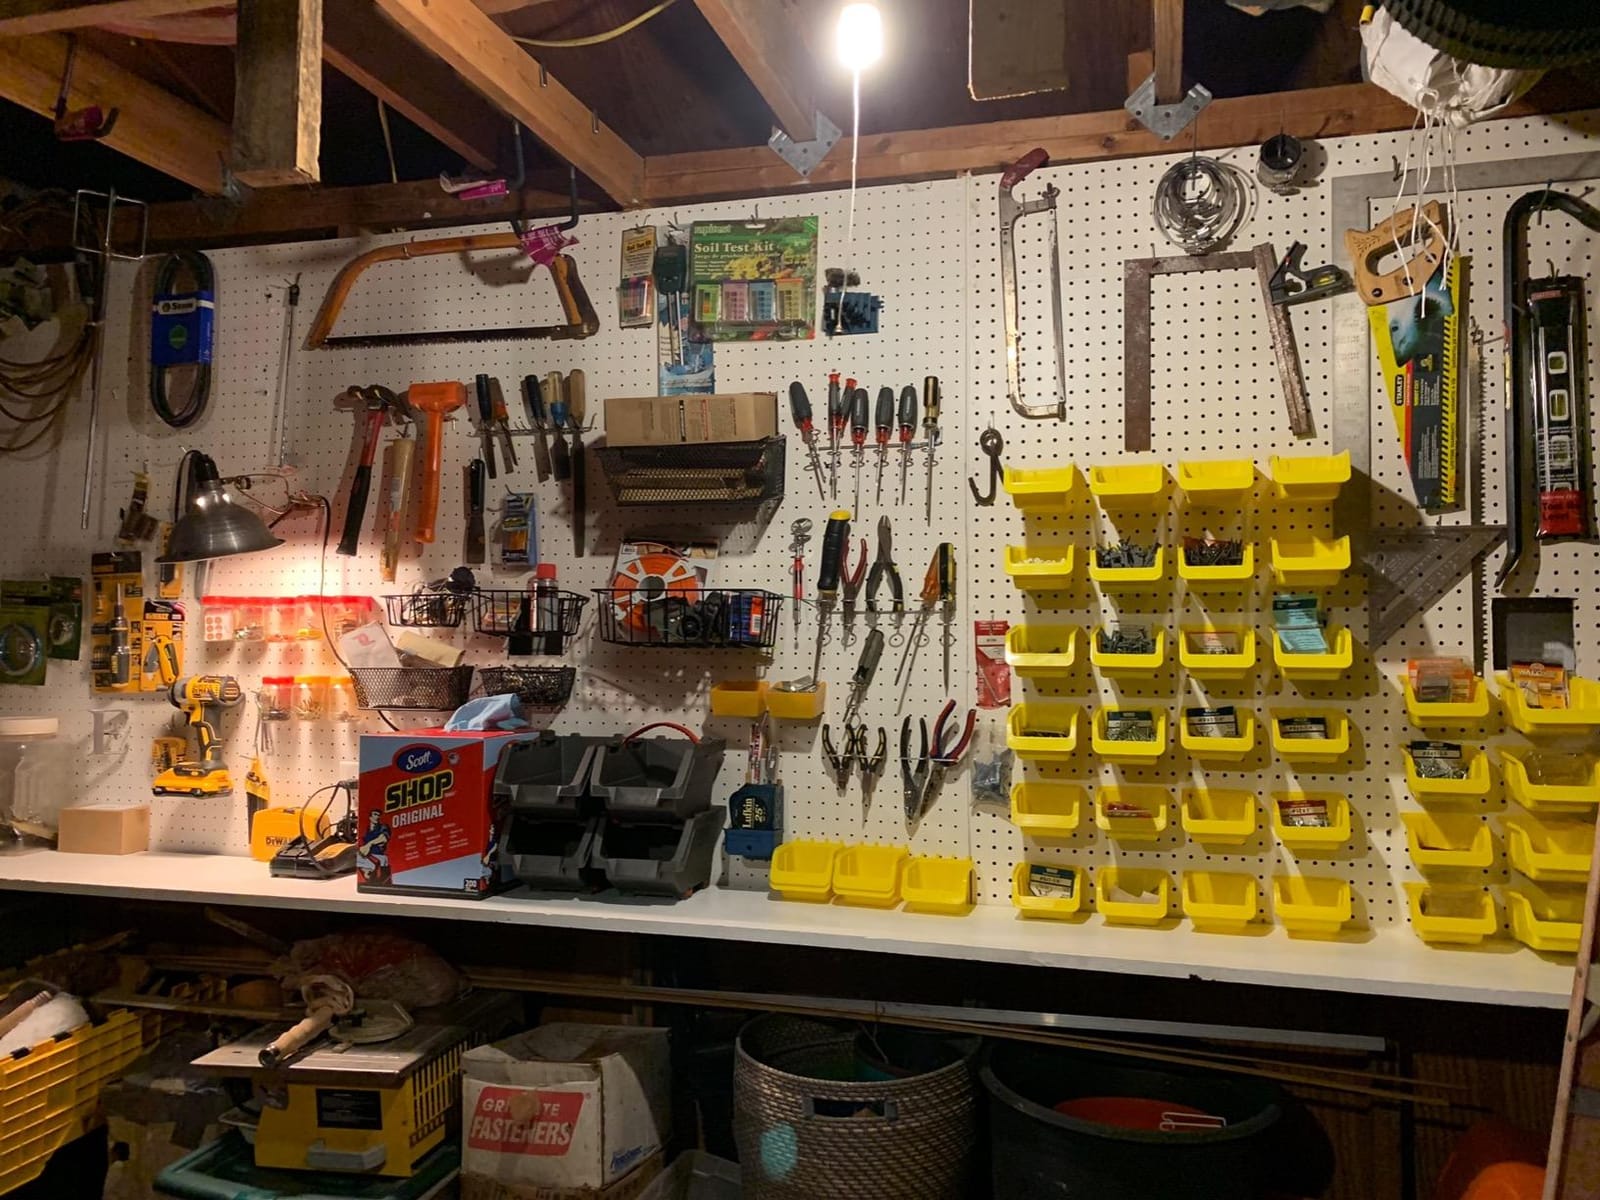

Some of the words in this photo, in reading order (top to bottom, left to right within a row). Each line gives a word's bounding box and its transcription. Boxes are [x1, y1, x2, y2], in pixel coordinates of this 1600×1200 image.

[694, 242, 719, 253] Soil
[723, 242, 749, 252] Test
[754, 240, 774, 251] Kit
[405, 750, 431, 771] Scott
[384, 769, 454, 813] SHOP
[392, 803, 445, 828] ORIGINAL
[741, 798, 753, 828] Lufkin
[471, 1116, 570, 1146] FASTENERS
